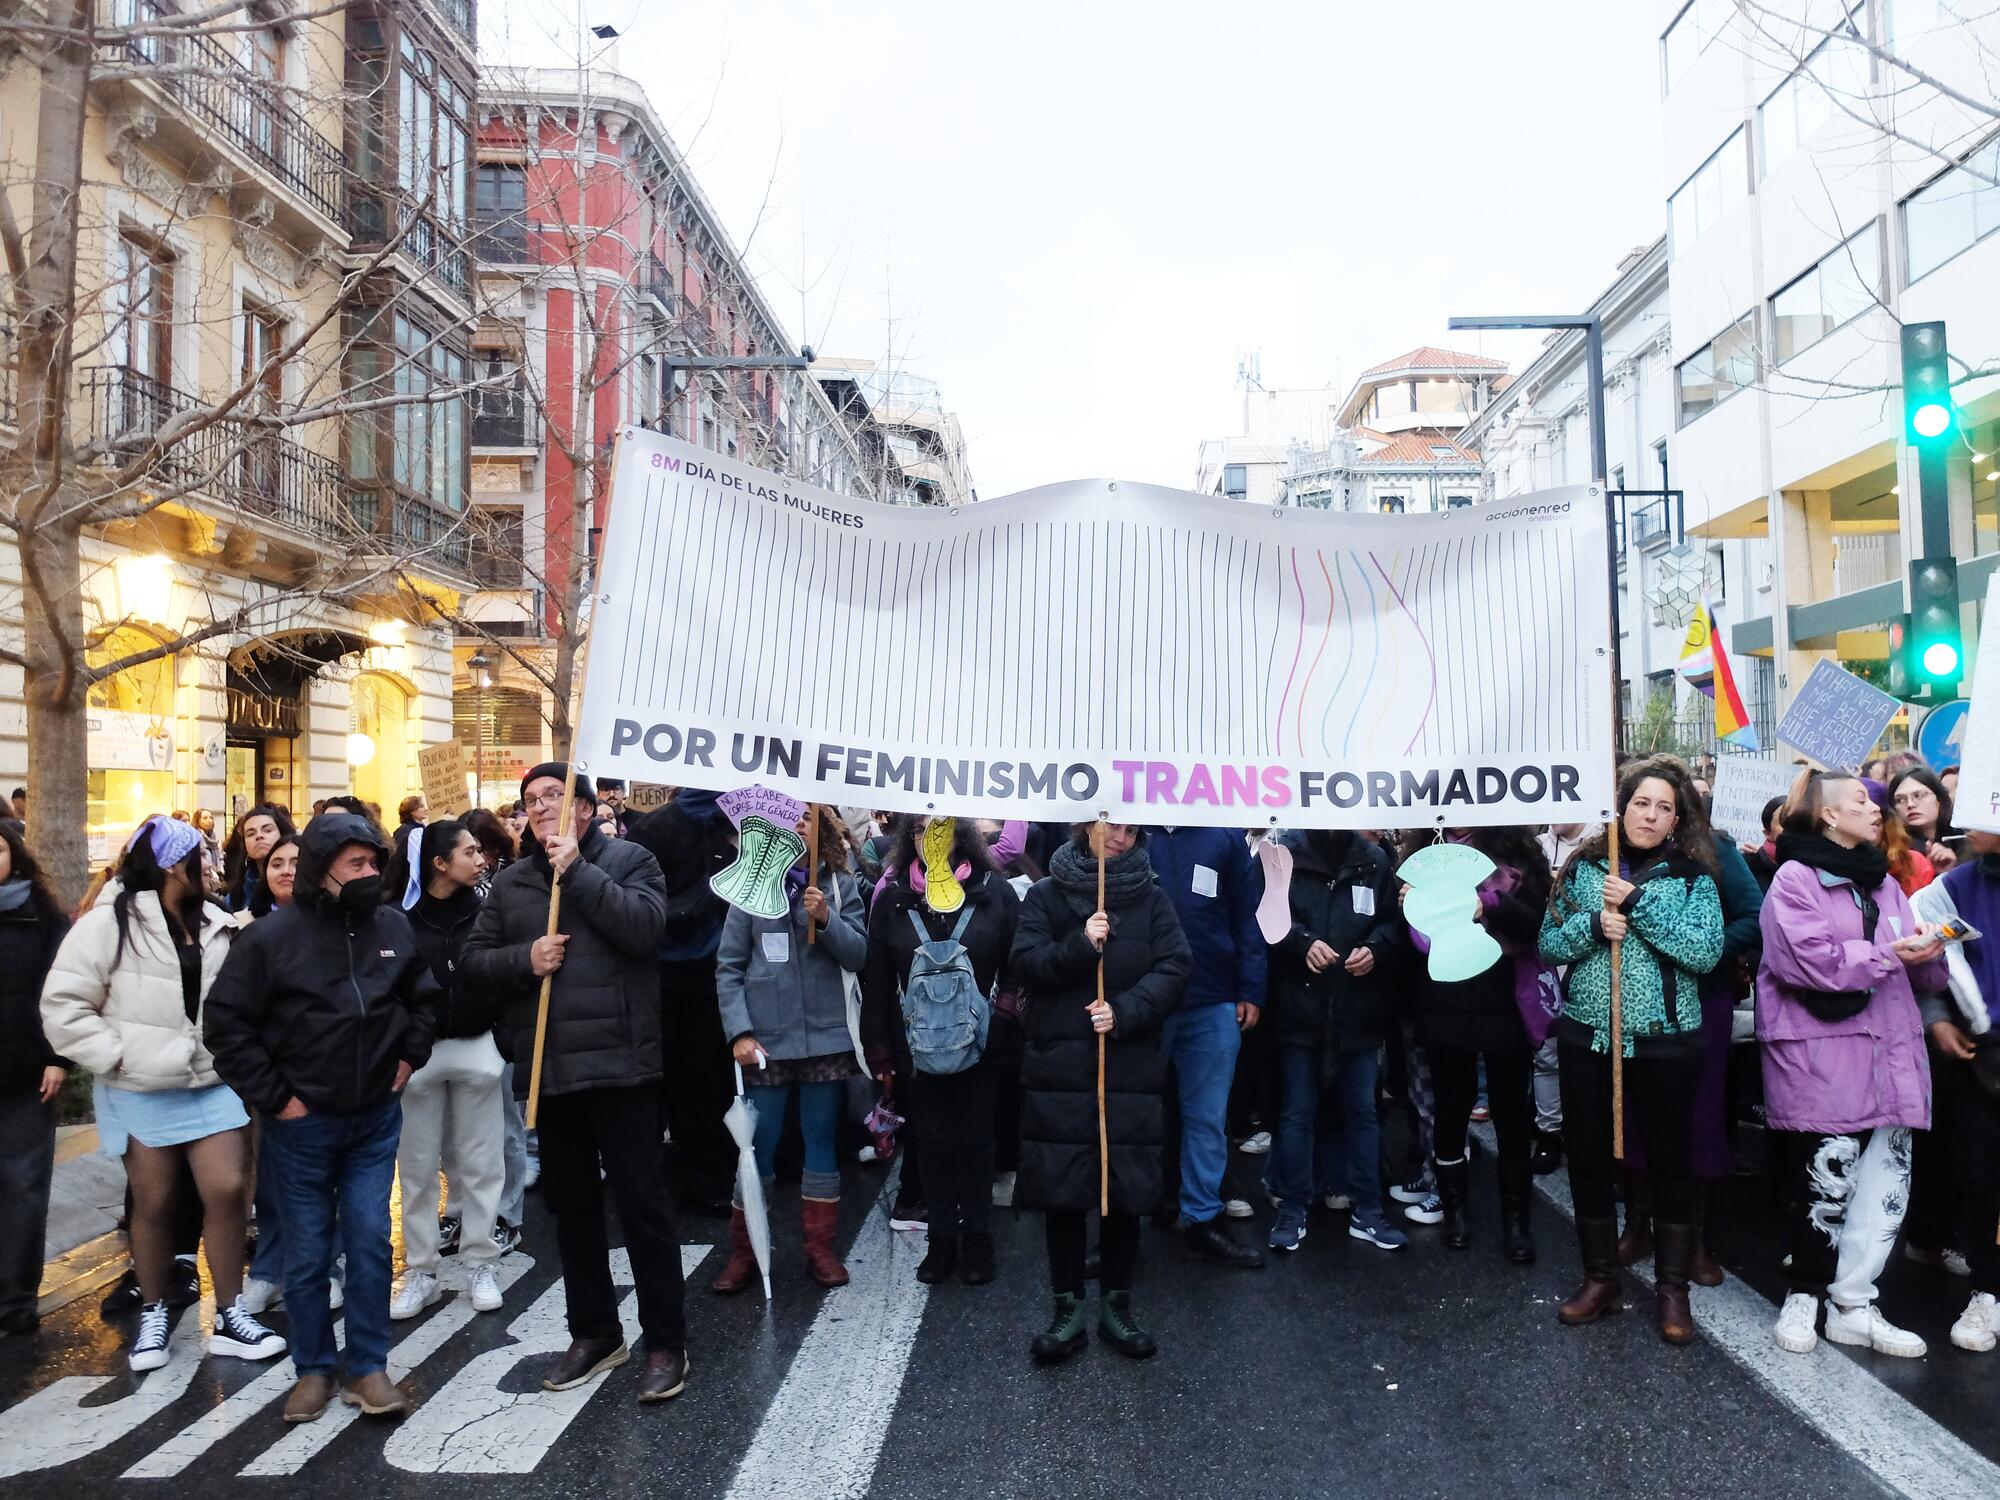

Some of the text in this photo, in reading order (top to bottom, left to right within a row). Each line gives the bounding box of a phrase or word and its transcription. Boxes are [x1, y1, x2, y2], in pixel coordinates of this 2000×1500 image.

[651, 452, 864, 529] 8M DÍA DE LAS MUJERES
[1814, 664, 1890, 719] NO HAY NADA
[1779, 716, 1820, 754] AULLAR
[1793, 701, 1865, 755] QUE VERNOS
[1833, 701, 1876, 736] BELLO
[609, 718, 1581, 809] POR UN FEMINISMO TRANS FORMADOR
[1722, 761, 1780, 787] TRATARON
[633, 786, 671, 806] FUERT
[720, 788, 799, 810] NO ME CABE EL
[755, 801, 767, 811] DE
[767, 804, 800, 823] GÉNERO
